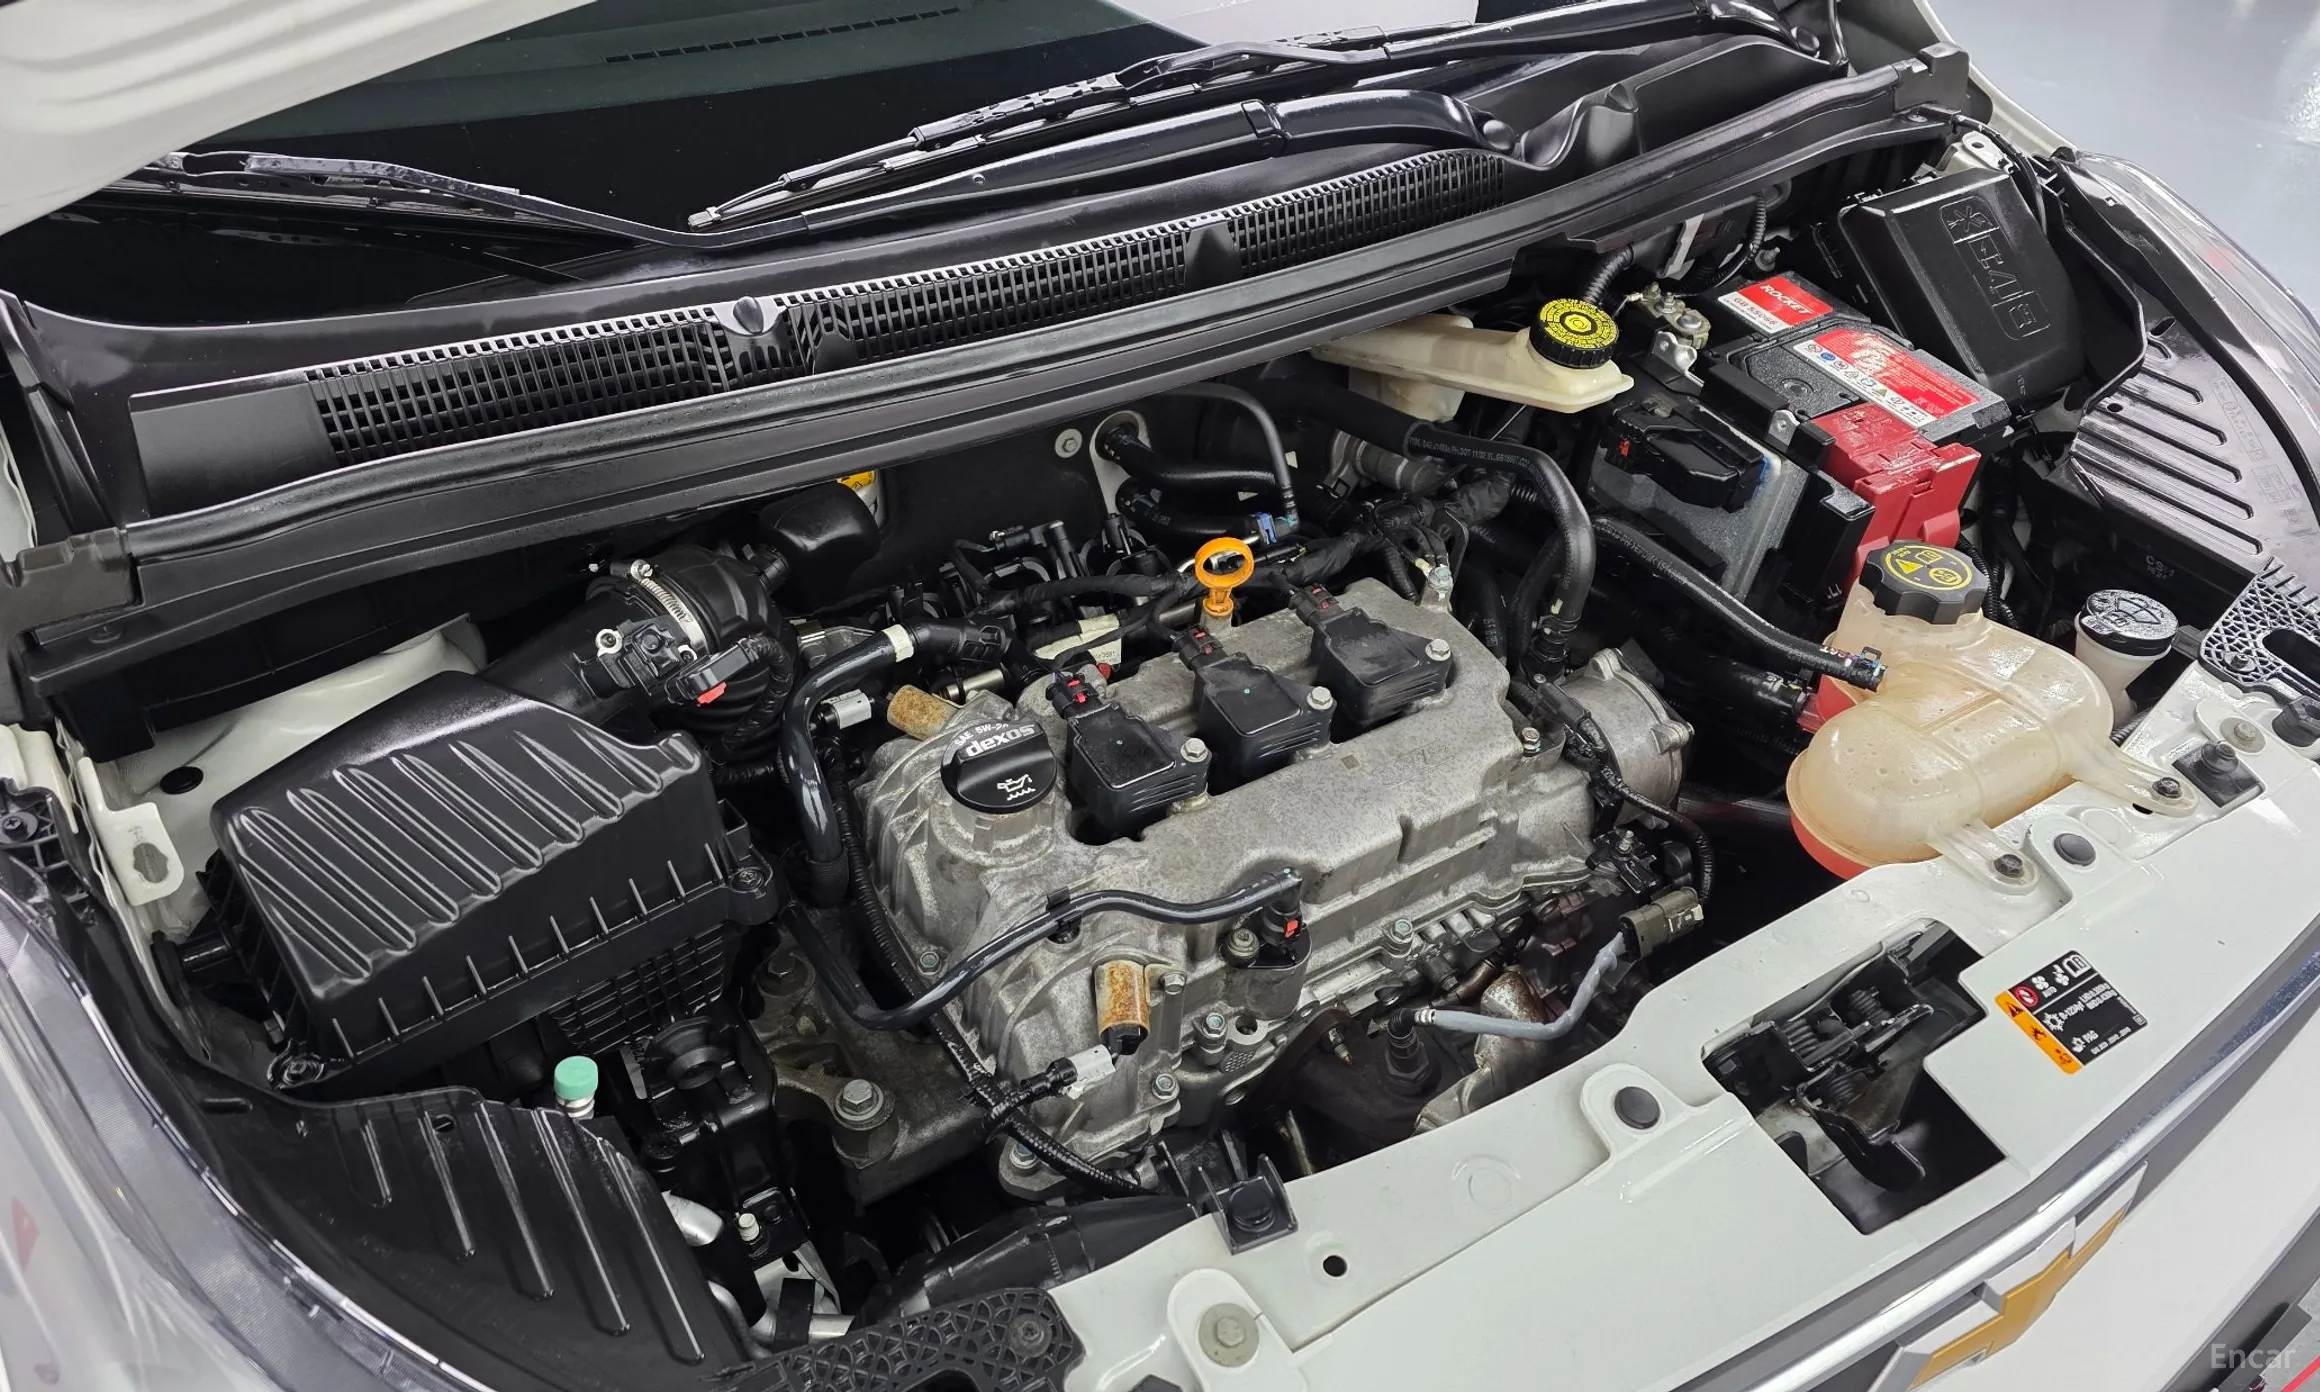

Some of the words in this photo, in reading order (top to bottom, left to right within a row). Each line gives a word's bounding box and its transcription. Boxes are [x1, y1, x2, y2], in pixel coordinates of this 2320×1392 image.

[1760, 284, 1814, 314] ROCKET
[954, 730, 974, 747] SAE
[965, 726, 1036, 757] dexos
[2082, 1030, 2100, 1044] PAG
